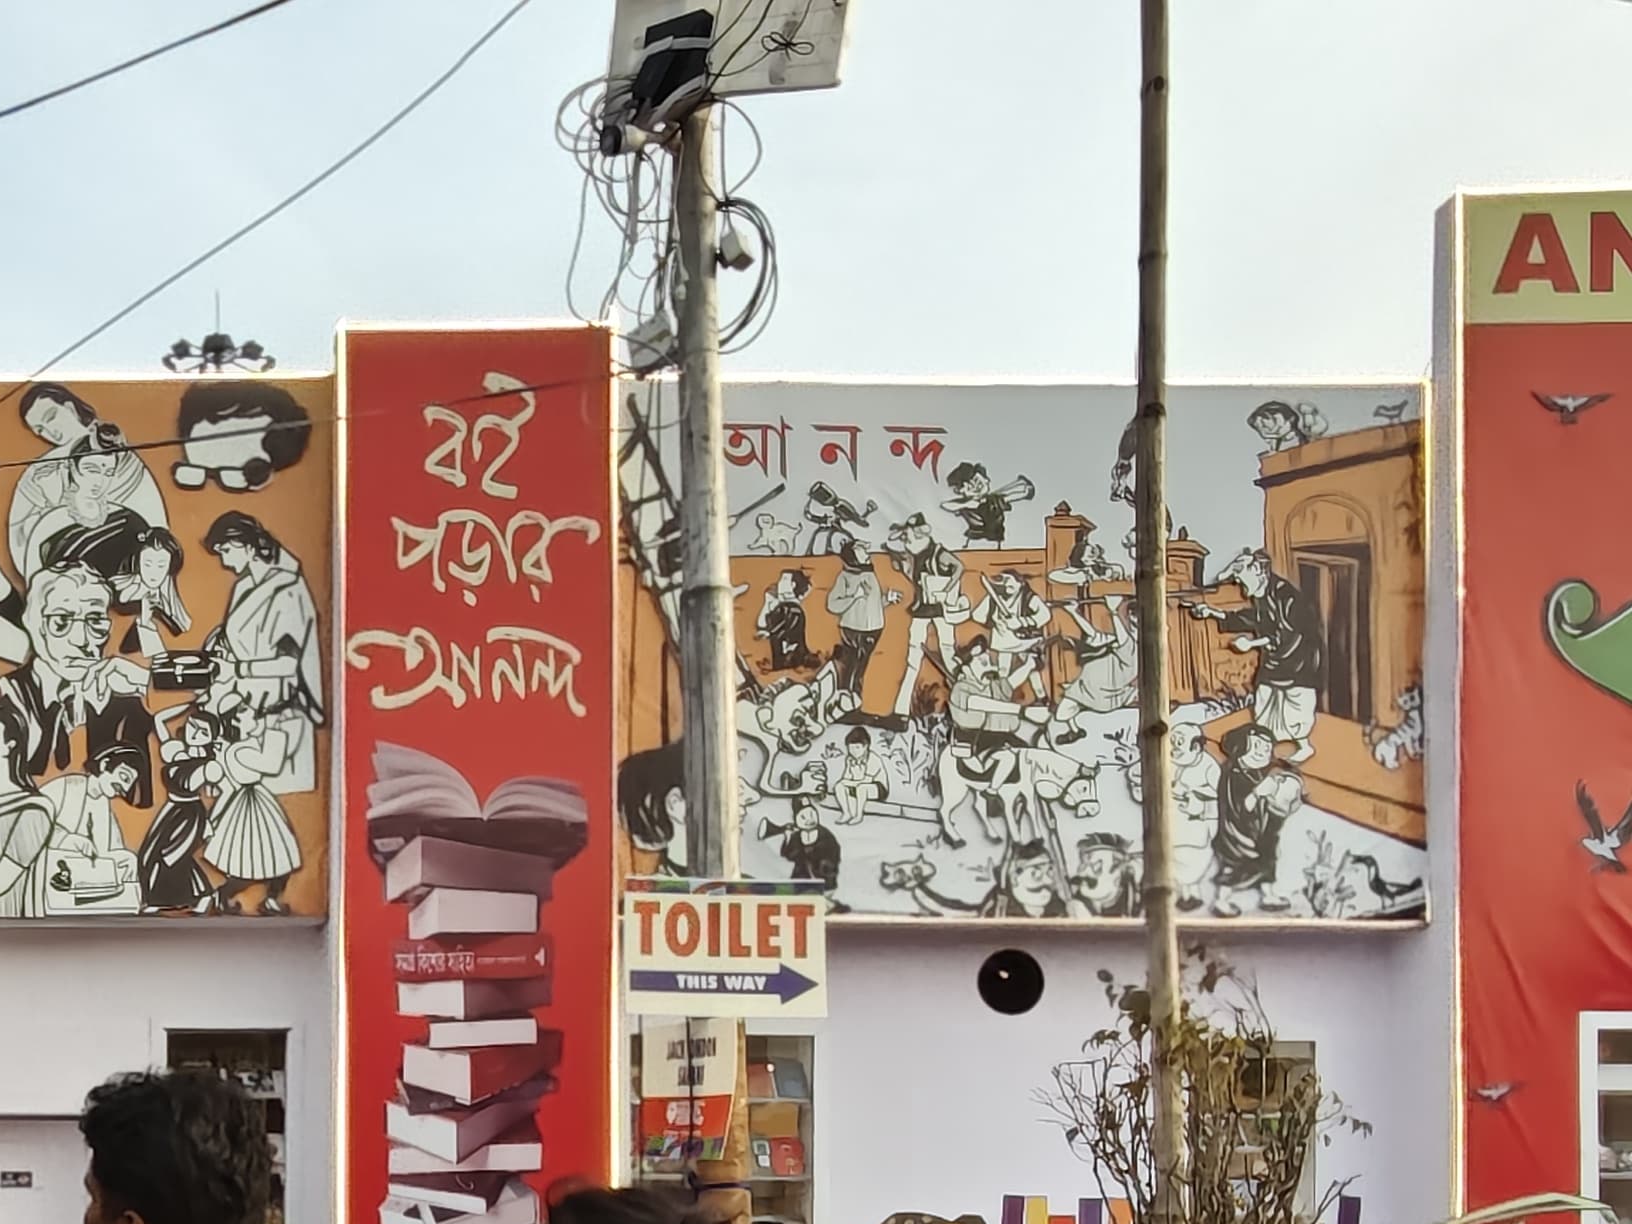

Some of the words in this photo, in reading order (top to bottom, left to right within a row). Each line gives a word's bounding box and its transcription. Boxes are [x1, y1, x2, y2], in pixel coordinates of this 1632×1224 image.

[423, 371, 535, 499] বই
[391, 508, 601, 607] পড়ার
[346, 625, 587, 717] আনন্দ
[633, 901, 815, 959] TOILET
[676, 974, 718, 990] THIS
[723, 975, 767, 991] WAY
